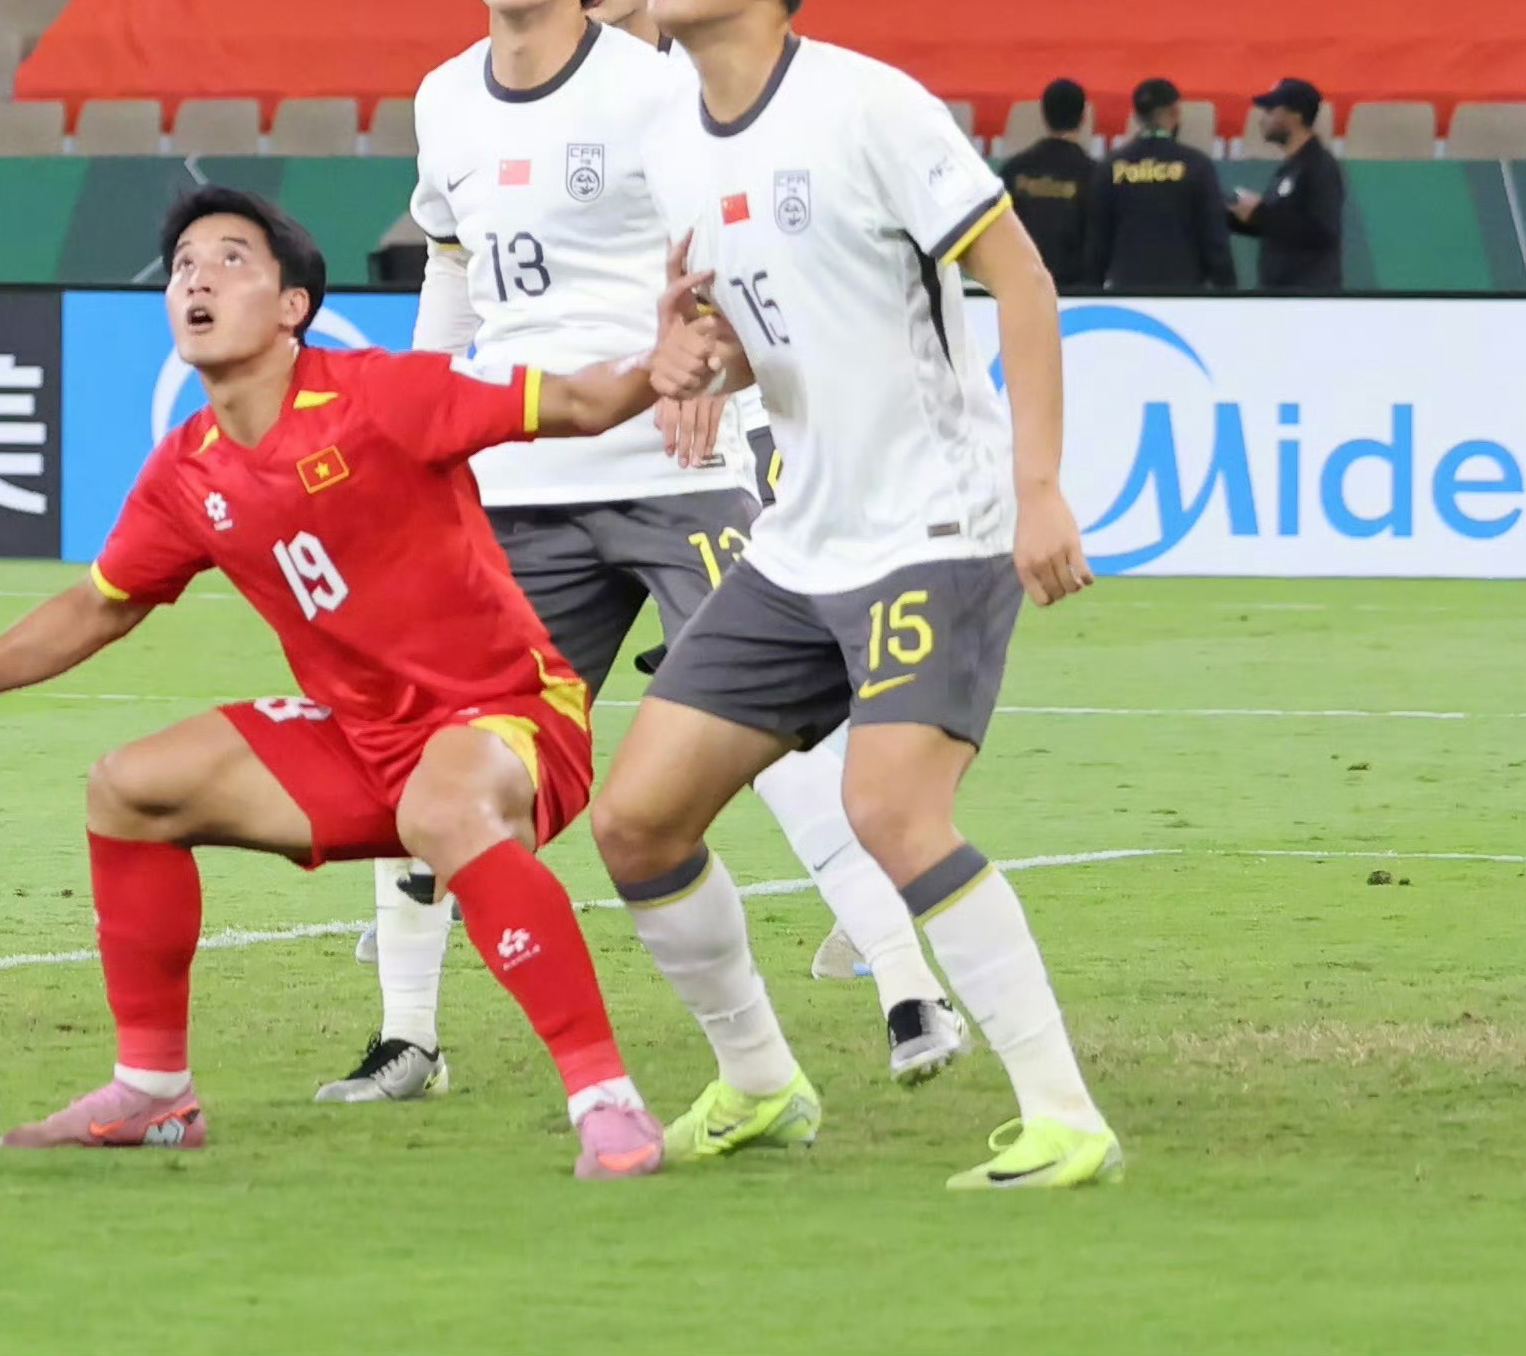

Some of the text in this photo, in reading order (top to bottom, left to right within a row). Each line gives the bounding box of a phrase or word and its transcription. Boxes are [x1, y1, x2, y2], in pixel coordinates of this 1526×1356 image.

[1112, 157, 1187, 184] Police
[484, 230, 552, 302] 13
[272, 530, 349, 622] 19
[868, 589, 934, 672] 15
